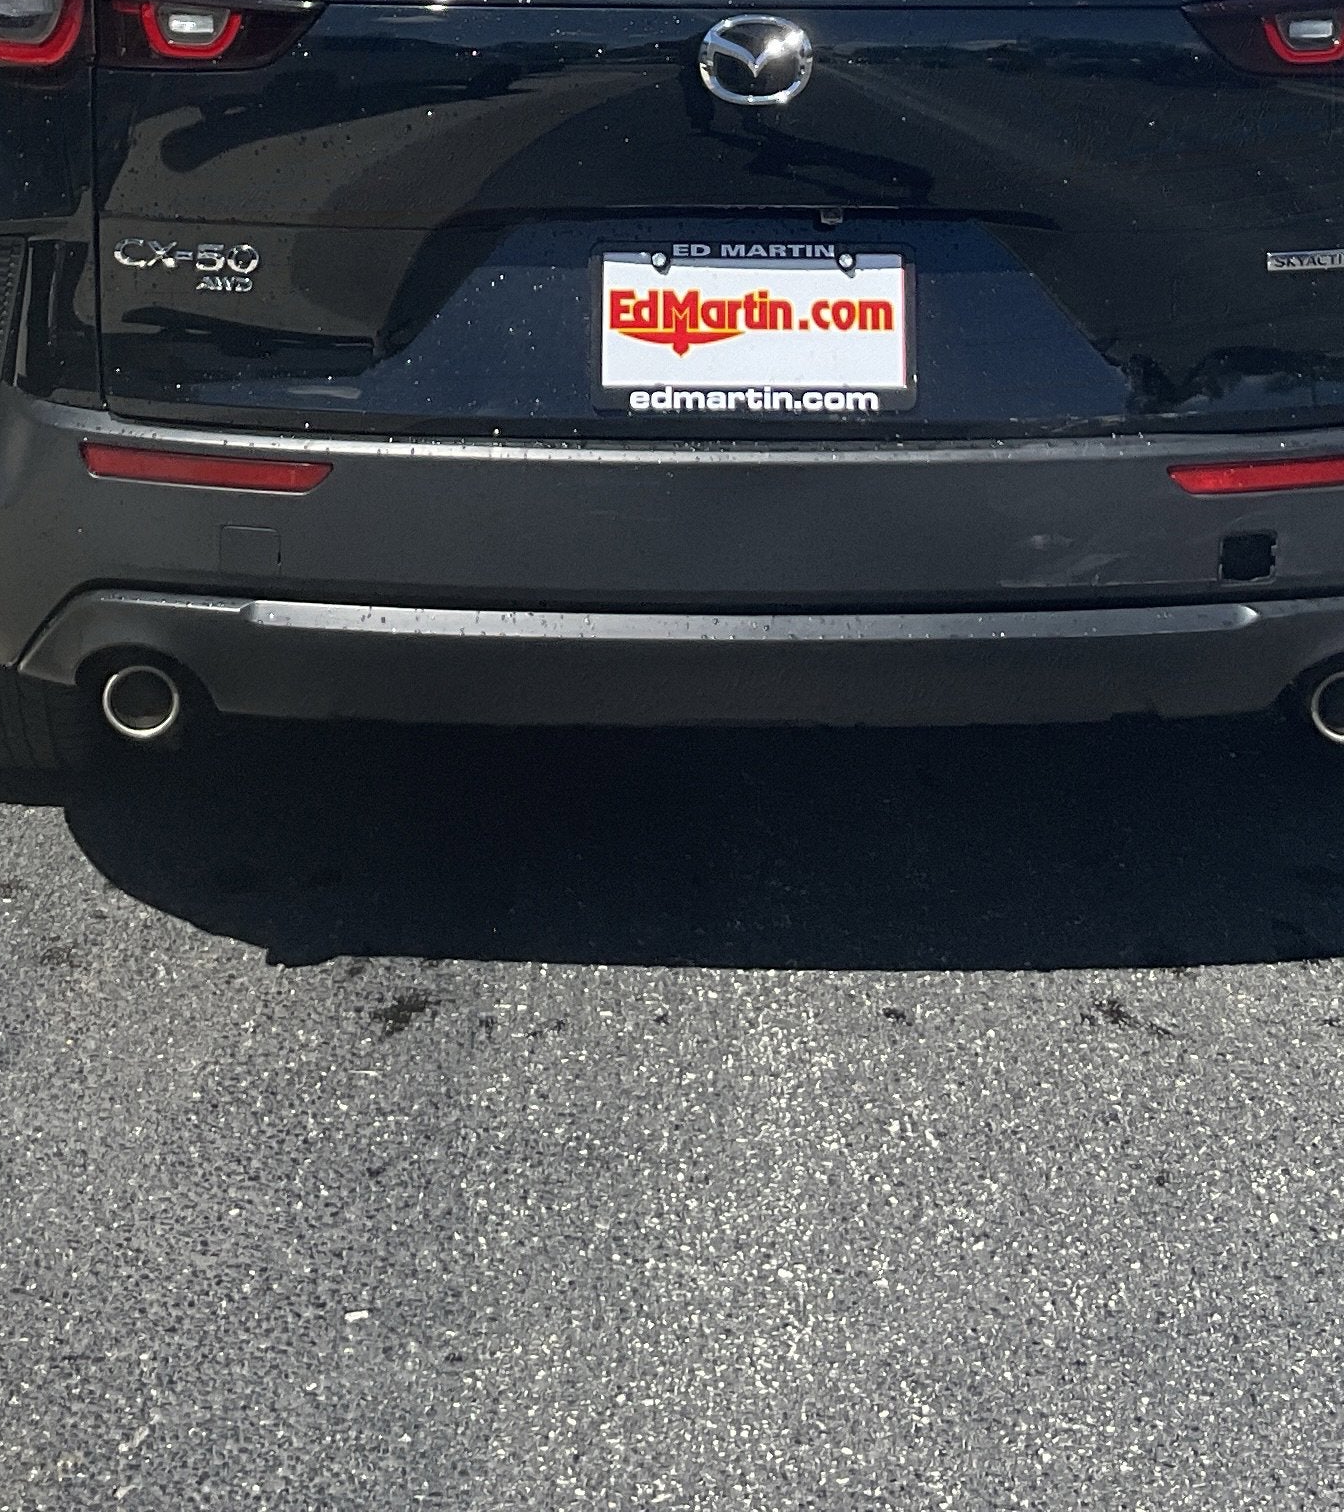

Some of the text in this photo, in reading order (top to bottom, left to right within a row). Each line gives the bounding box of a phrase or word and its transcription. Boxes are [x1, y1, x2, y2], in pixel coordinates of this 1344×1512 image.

[113, 238, 260, 274] CX-50
[673, 244, 835, 257] ED MARTIN
[196, 276, 253, 292] AWD
[609, 289, 894, 334] EdMartin.com
[629, 387, 879, 411] edmartin.com
